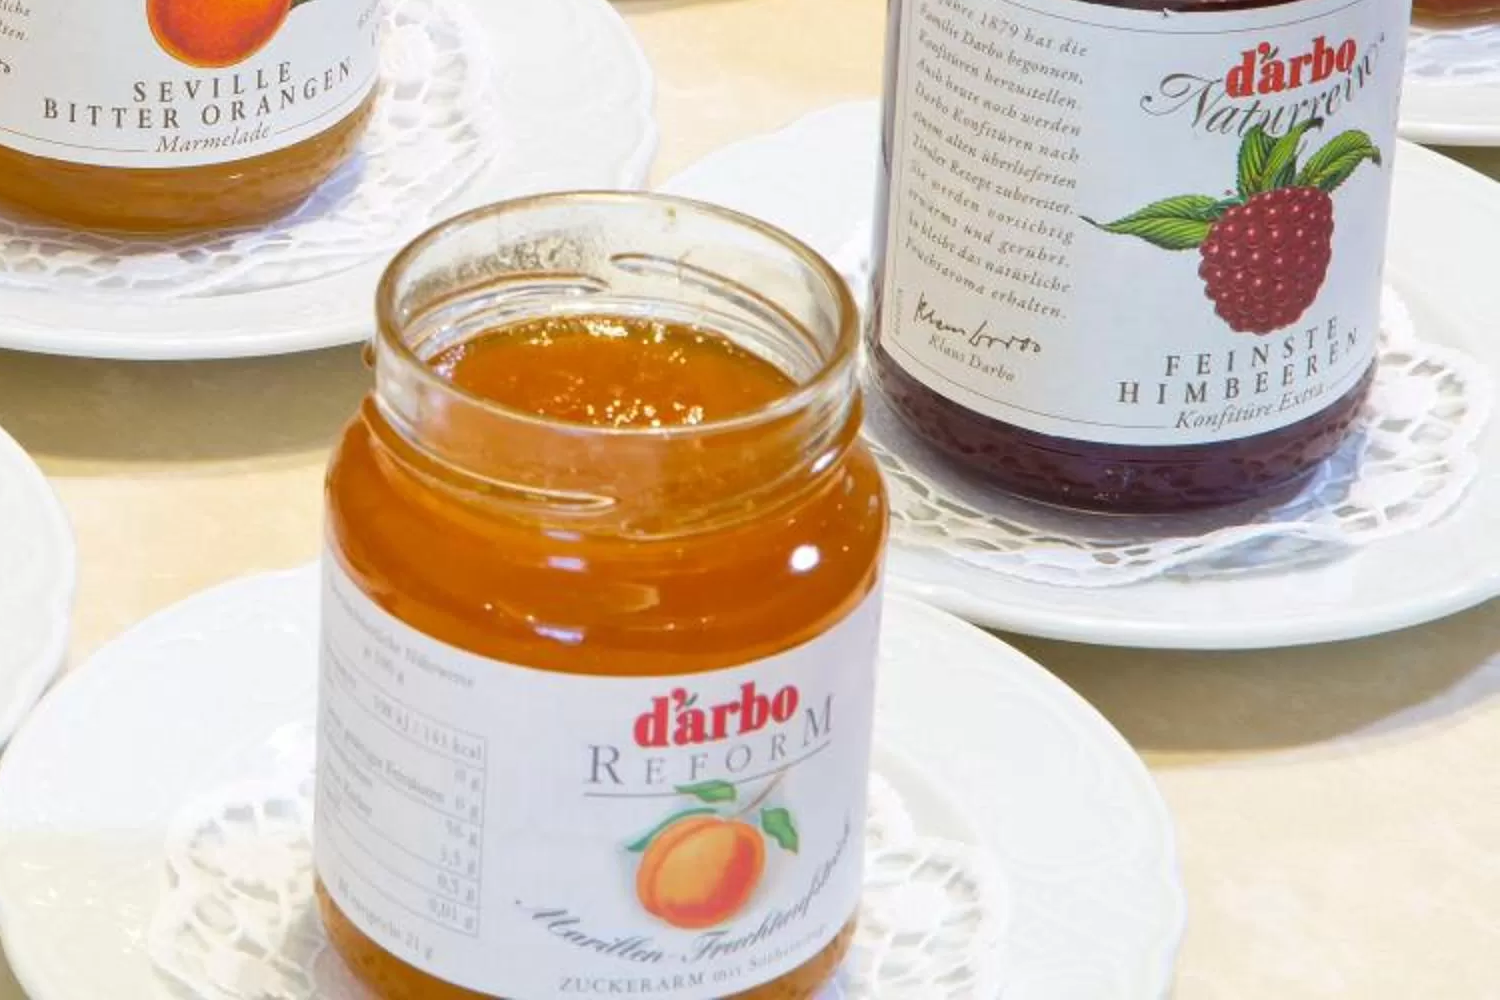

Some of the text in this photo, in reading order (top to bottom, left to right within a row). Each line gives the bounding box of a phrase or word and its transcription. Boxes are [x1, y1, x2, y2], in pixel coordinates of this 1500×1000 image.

[980, 12, 1020, 38] 1879
[1059, 39, 1088, 58] die
[44, 56, 353, 130] BITTER ORANGEN
[133, 60, 292, 103] SEVILLE
[156, 123, 271, 154] Marmelade
[1118, 327, 1358, 404] HIMBEEREN
[1165, 316, 1338, 377] FEINSTE
[584, 692, 835, 786] REFORM
[558, 971, 706, 994] ZUCKERARM
